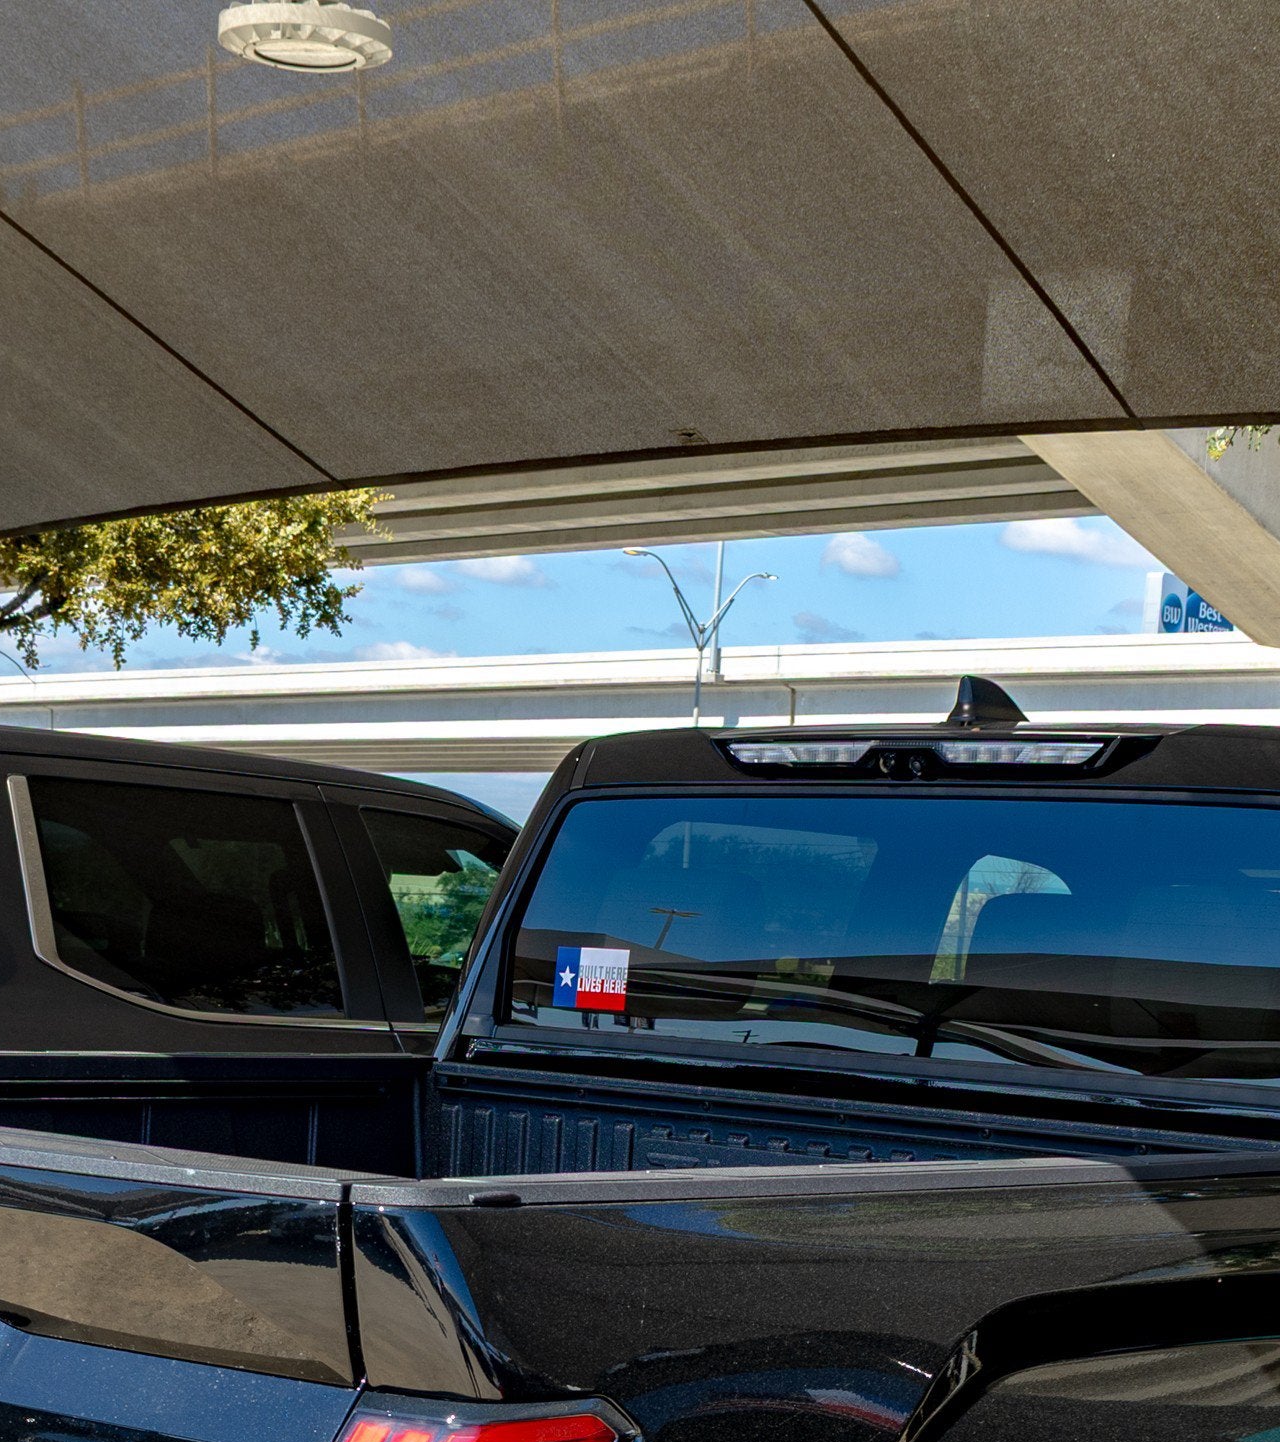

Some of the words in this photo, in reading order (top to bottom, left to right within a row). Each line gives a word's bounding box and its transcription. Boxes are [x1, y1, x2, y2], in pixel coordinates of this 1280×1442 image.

[1163, 605, 1181, 624] BW
[579, 965, 604, 980] BUILT
[606, 966, 628, 981] HERE
[577, 978, 601, 993] LIVES
[603, 979, 628, 994] HERE
